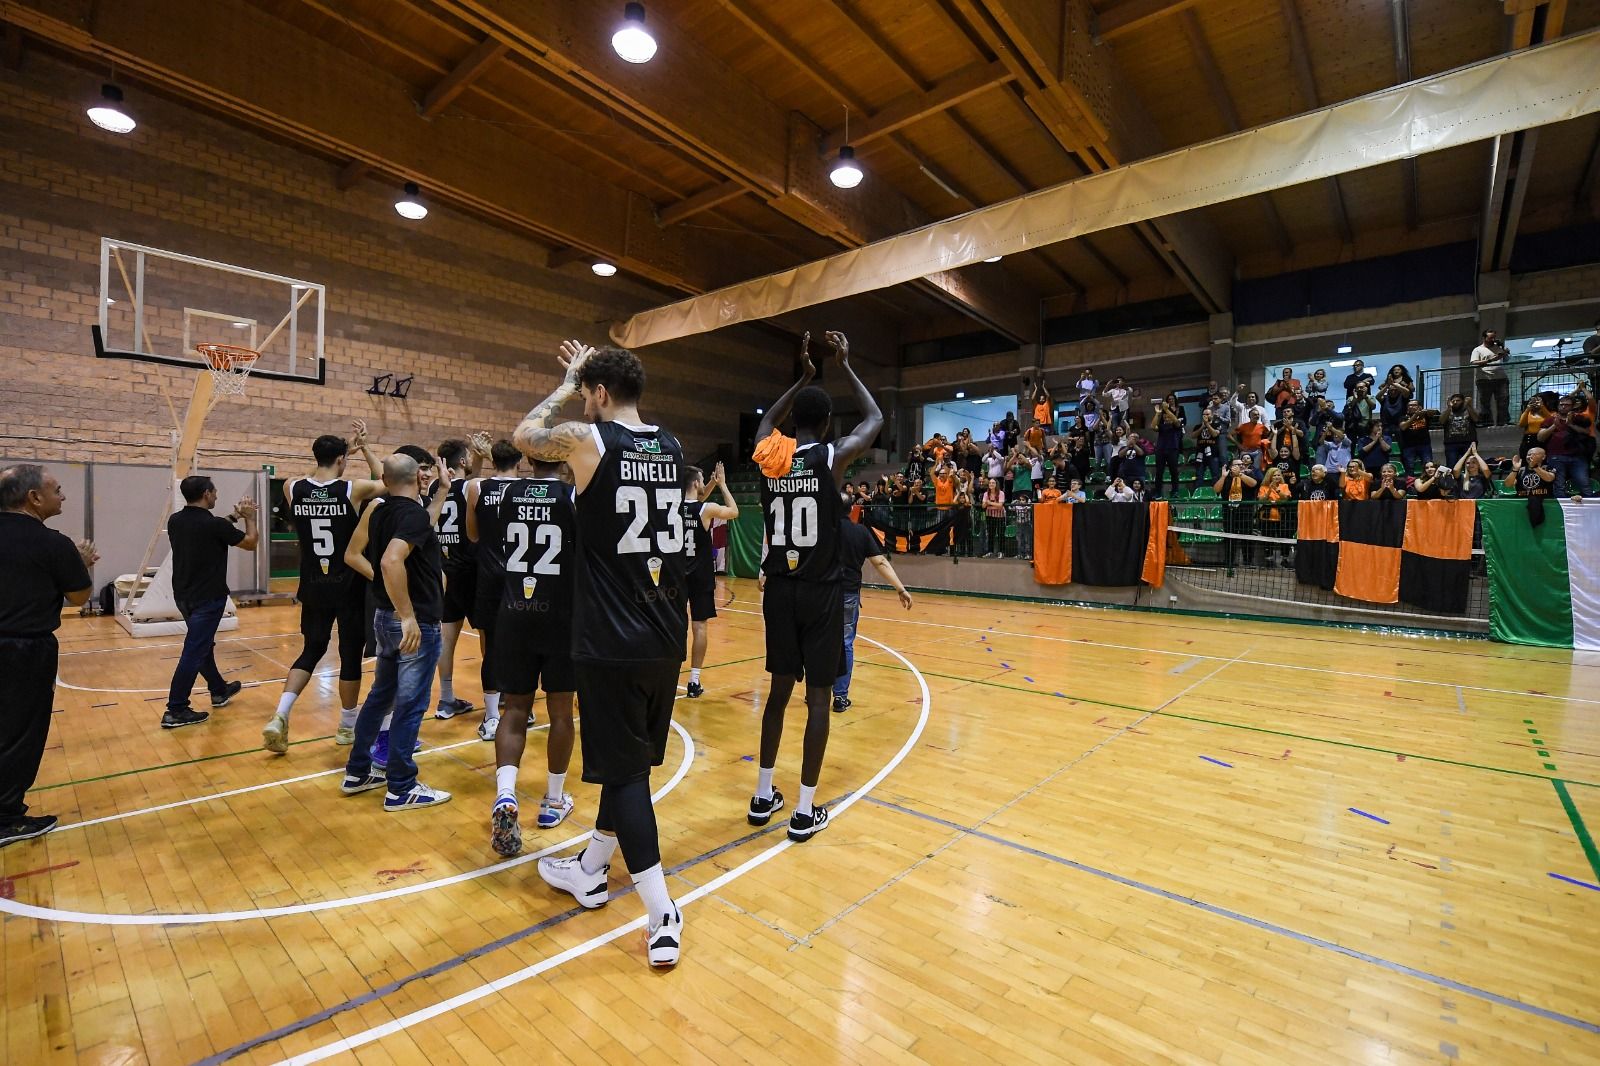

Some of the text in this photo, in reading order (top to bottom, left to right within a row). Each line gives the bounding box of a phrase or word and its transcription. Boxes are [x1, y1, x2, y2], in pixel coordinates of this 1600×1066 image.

[623, 450, 673, 462] PAVONE GOMME
[620, 460, 677, 482] BINELLI
[767, 478, 819, 493] YUSUPHA
[294, 503, 347, 516] AGUZZOLI
[518, 505, 551, 521] SECK
[616, 485, 684, 555] 23
[770, 496, 818, 547] 10
[310, 518, 335, 556] 5
[506, 522, 562, 576] 22
